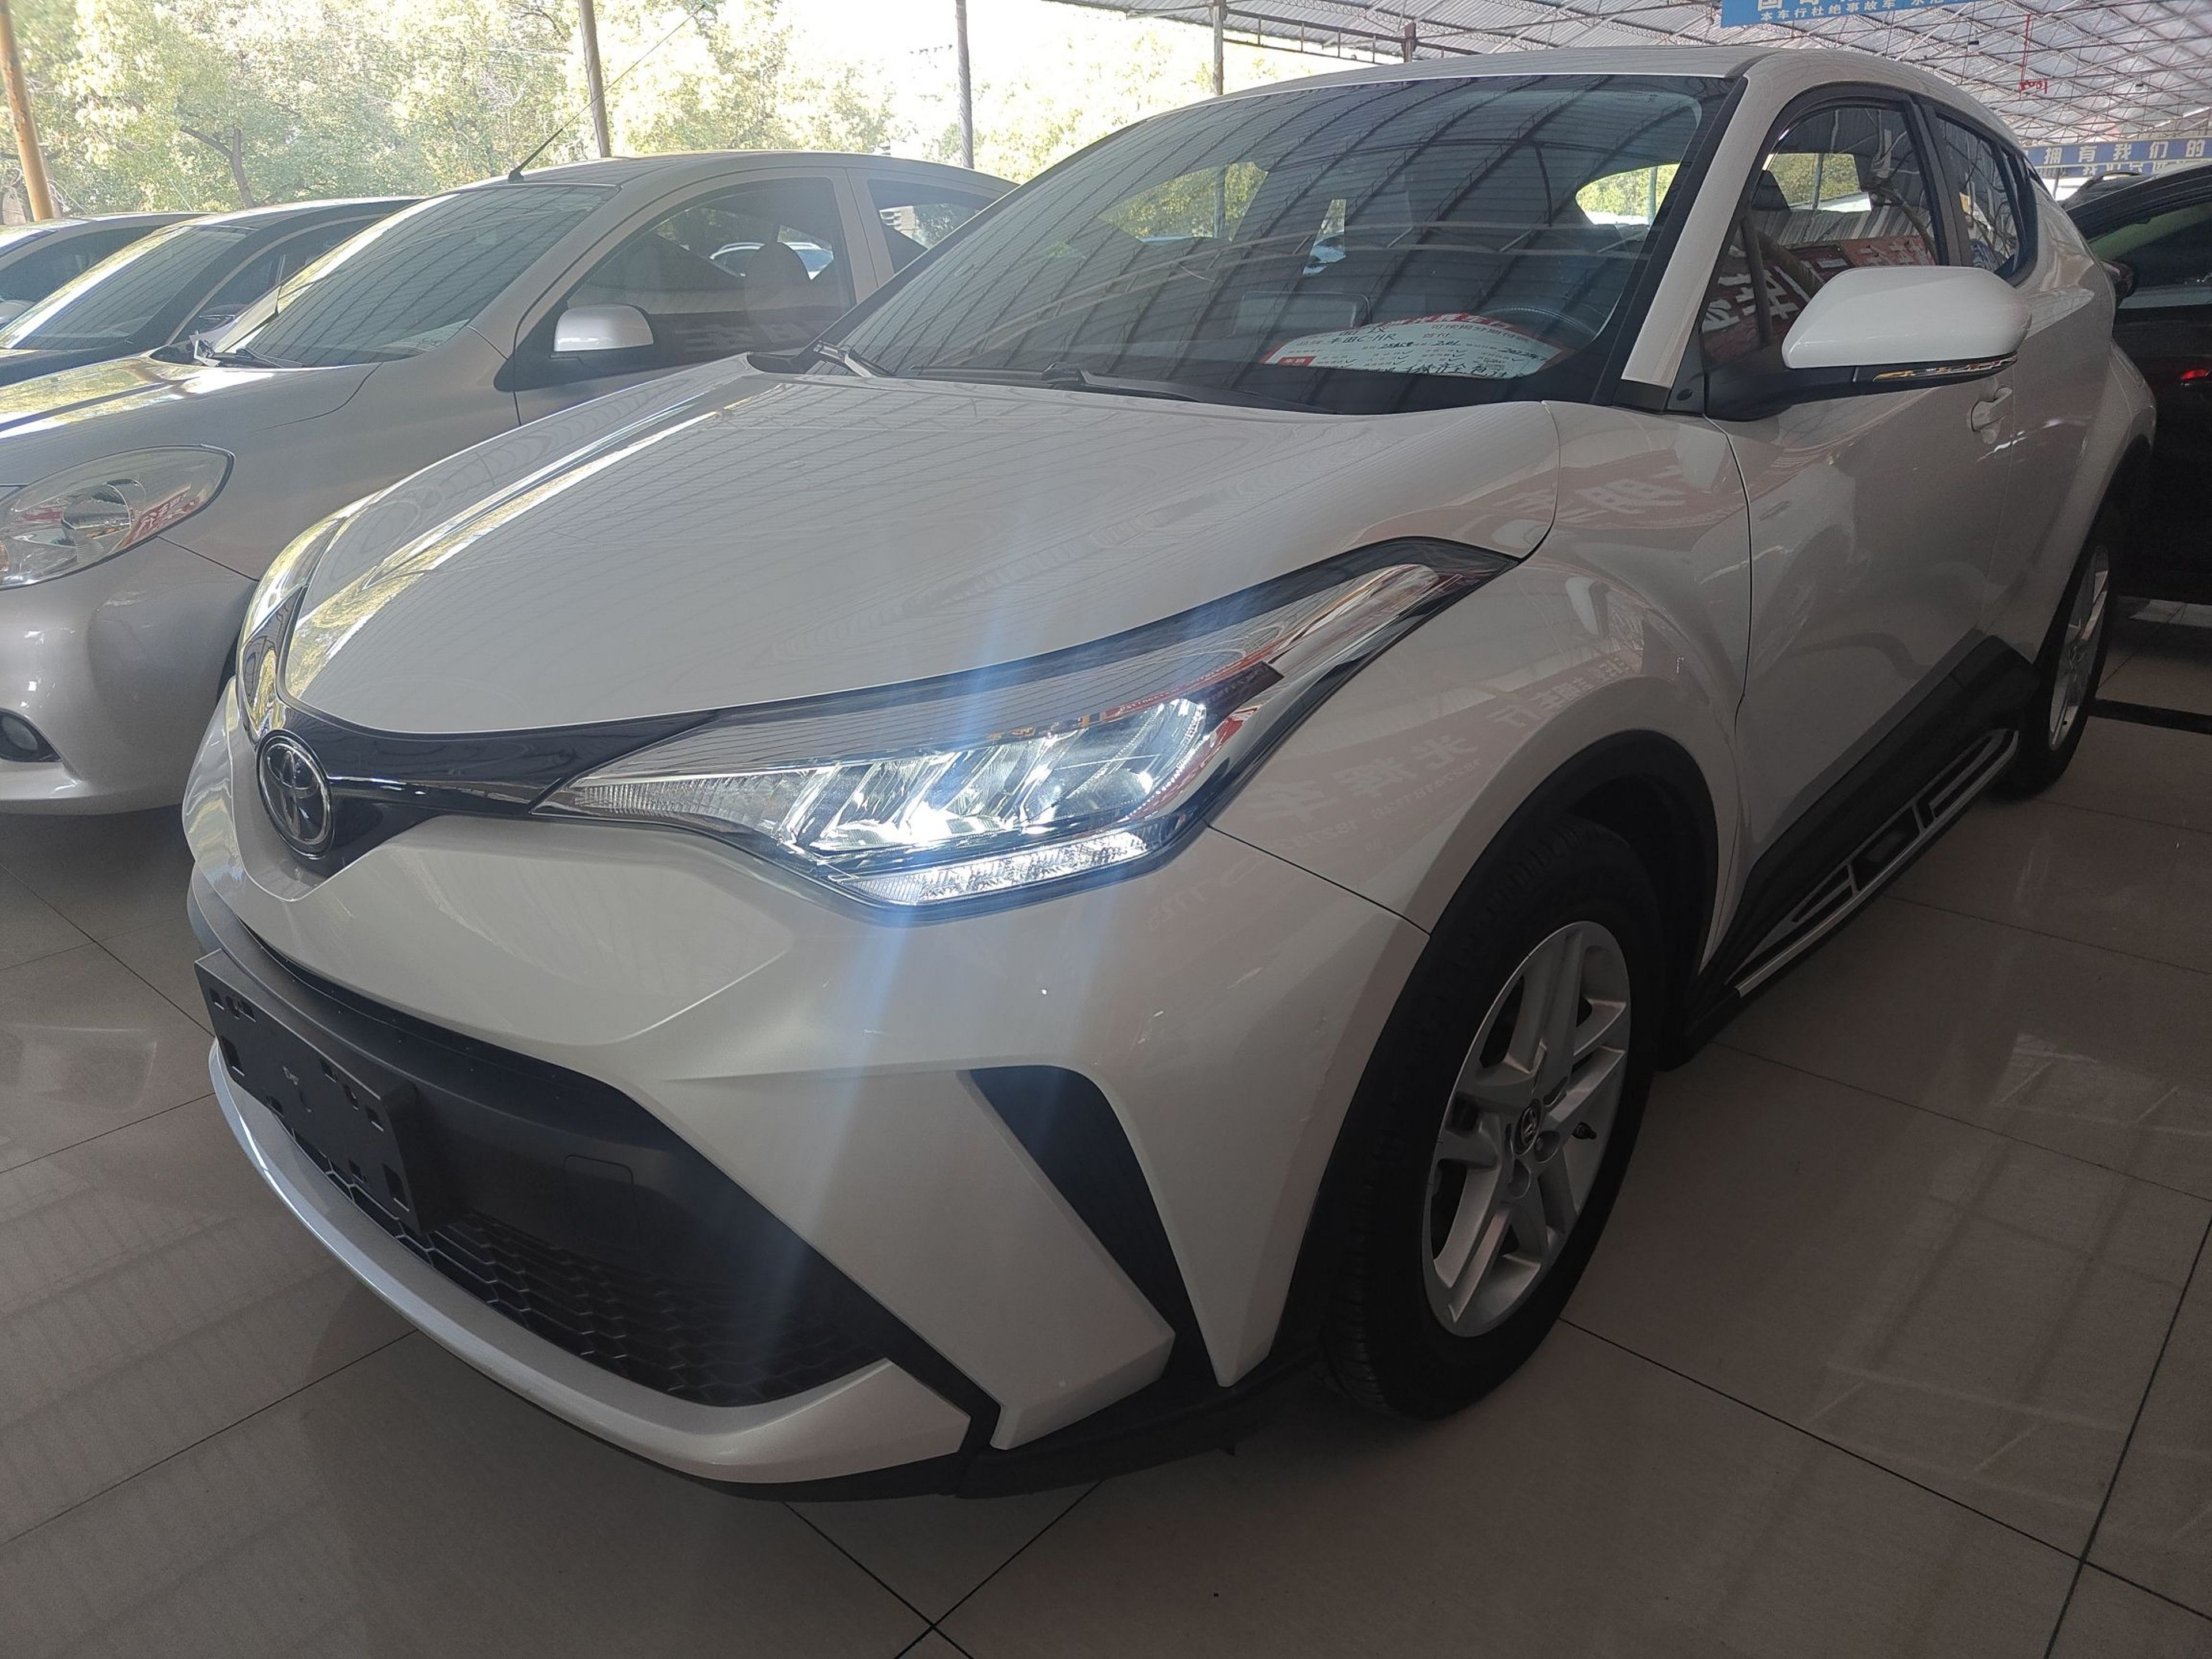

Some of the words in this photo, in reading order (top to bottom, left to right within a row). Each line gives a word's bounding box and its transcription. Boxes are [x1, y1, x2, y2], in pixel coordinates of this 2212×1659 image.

[2023, 140, 2205, 164] 拥有我们的
